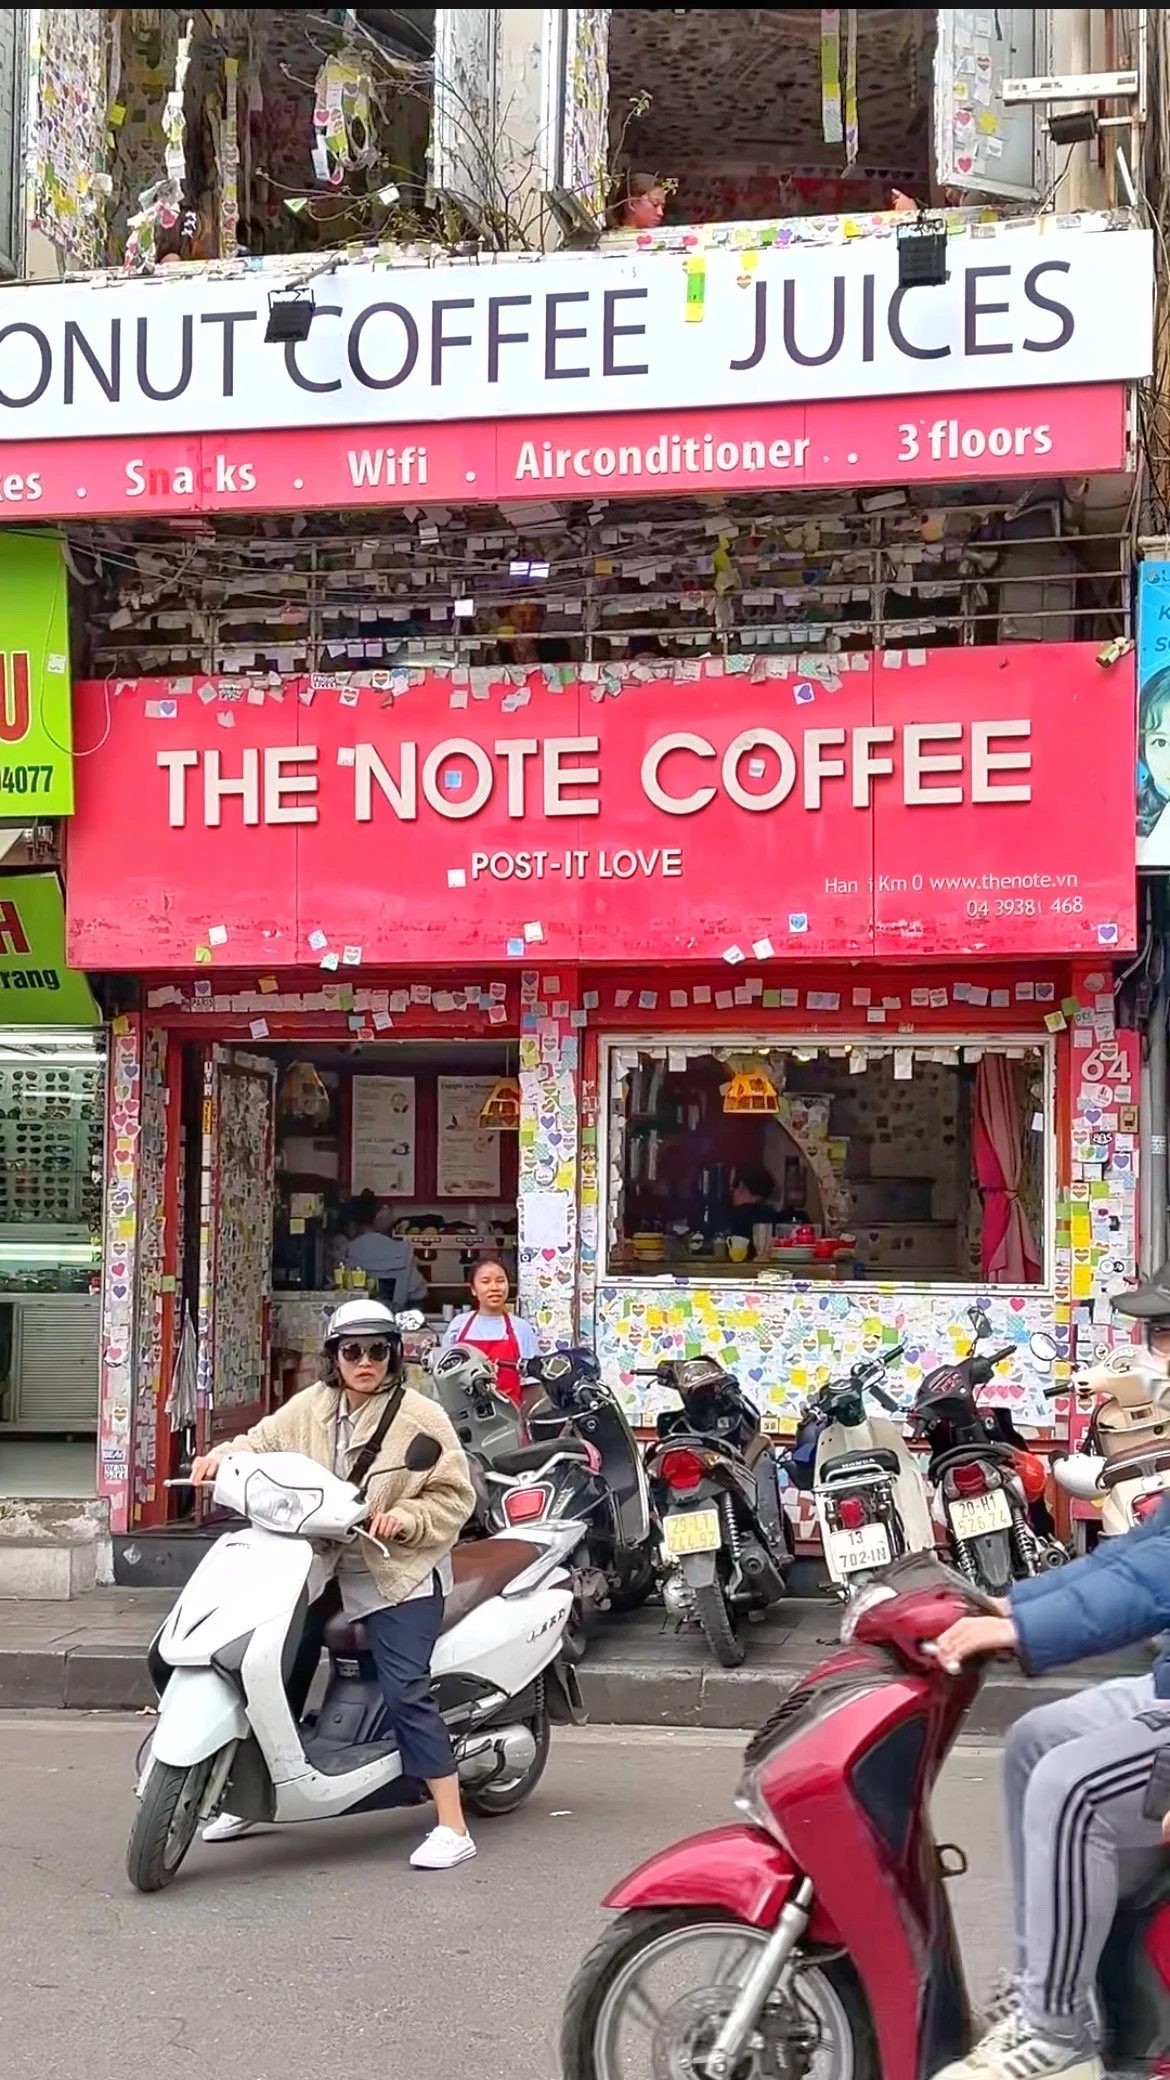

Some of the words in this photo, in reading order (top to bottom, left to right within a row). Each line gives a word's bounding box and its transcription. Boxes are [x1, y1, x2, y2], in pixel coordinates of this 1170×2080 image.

[0, 310, 257, 408] ONUT
[284, 287, 649, 393] COFFEE
[729, 260, 1075, 370] JUICES
[0, 471, 43, 502] es
[125, 454, 257, 497] Snacks
[347, 446, 428, 487] Wifi
[514, 434, 810, 480] Airconditioner
[156, 744, 318, 827] THE
[355, 736, 600, 821] NOTE
[640, 719, 1032, 815] COFFEE
[471, 850, 589, 879] POST-IT
[599, 848, 683, 879] LOVE
[879, 875, 908, 892] Km
[929, 872, 1078, 890] www.thenote.vn
[966, 898, 990, 917] 04
[1050, 895, 1084, 914] 468
[1081, 1049, 1132, 1083] 64
[848, 1530, 864, 1546] 13
